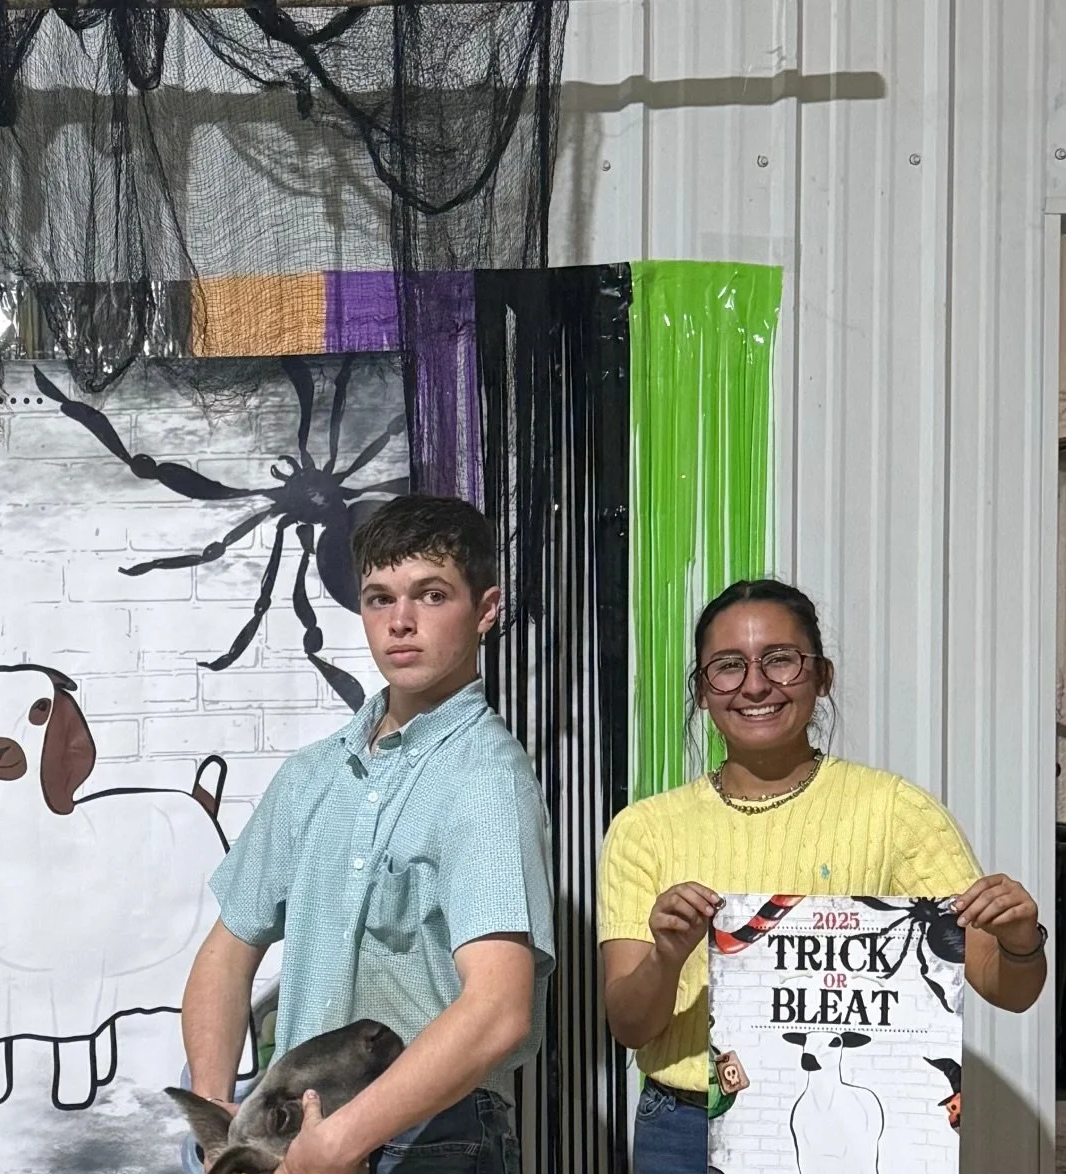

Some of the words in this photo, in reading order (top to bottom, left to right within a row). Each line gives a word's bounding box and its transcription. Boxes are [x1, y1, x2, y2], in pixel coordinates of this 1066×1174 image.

[813, 912, 860, 930] 2025
[768, 934, 895, 972] TRICK
[823, 973, 847, 988] OR
[770, 987, 899, 1026] BLEAT
